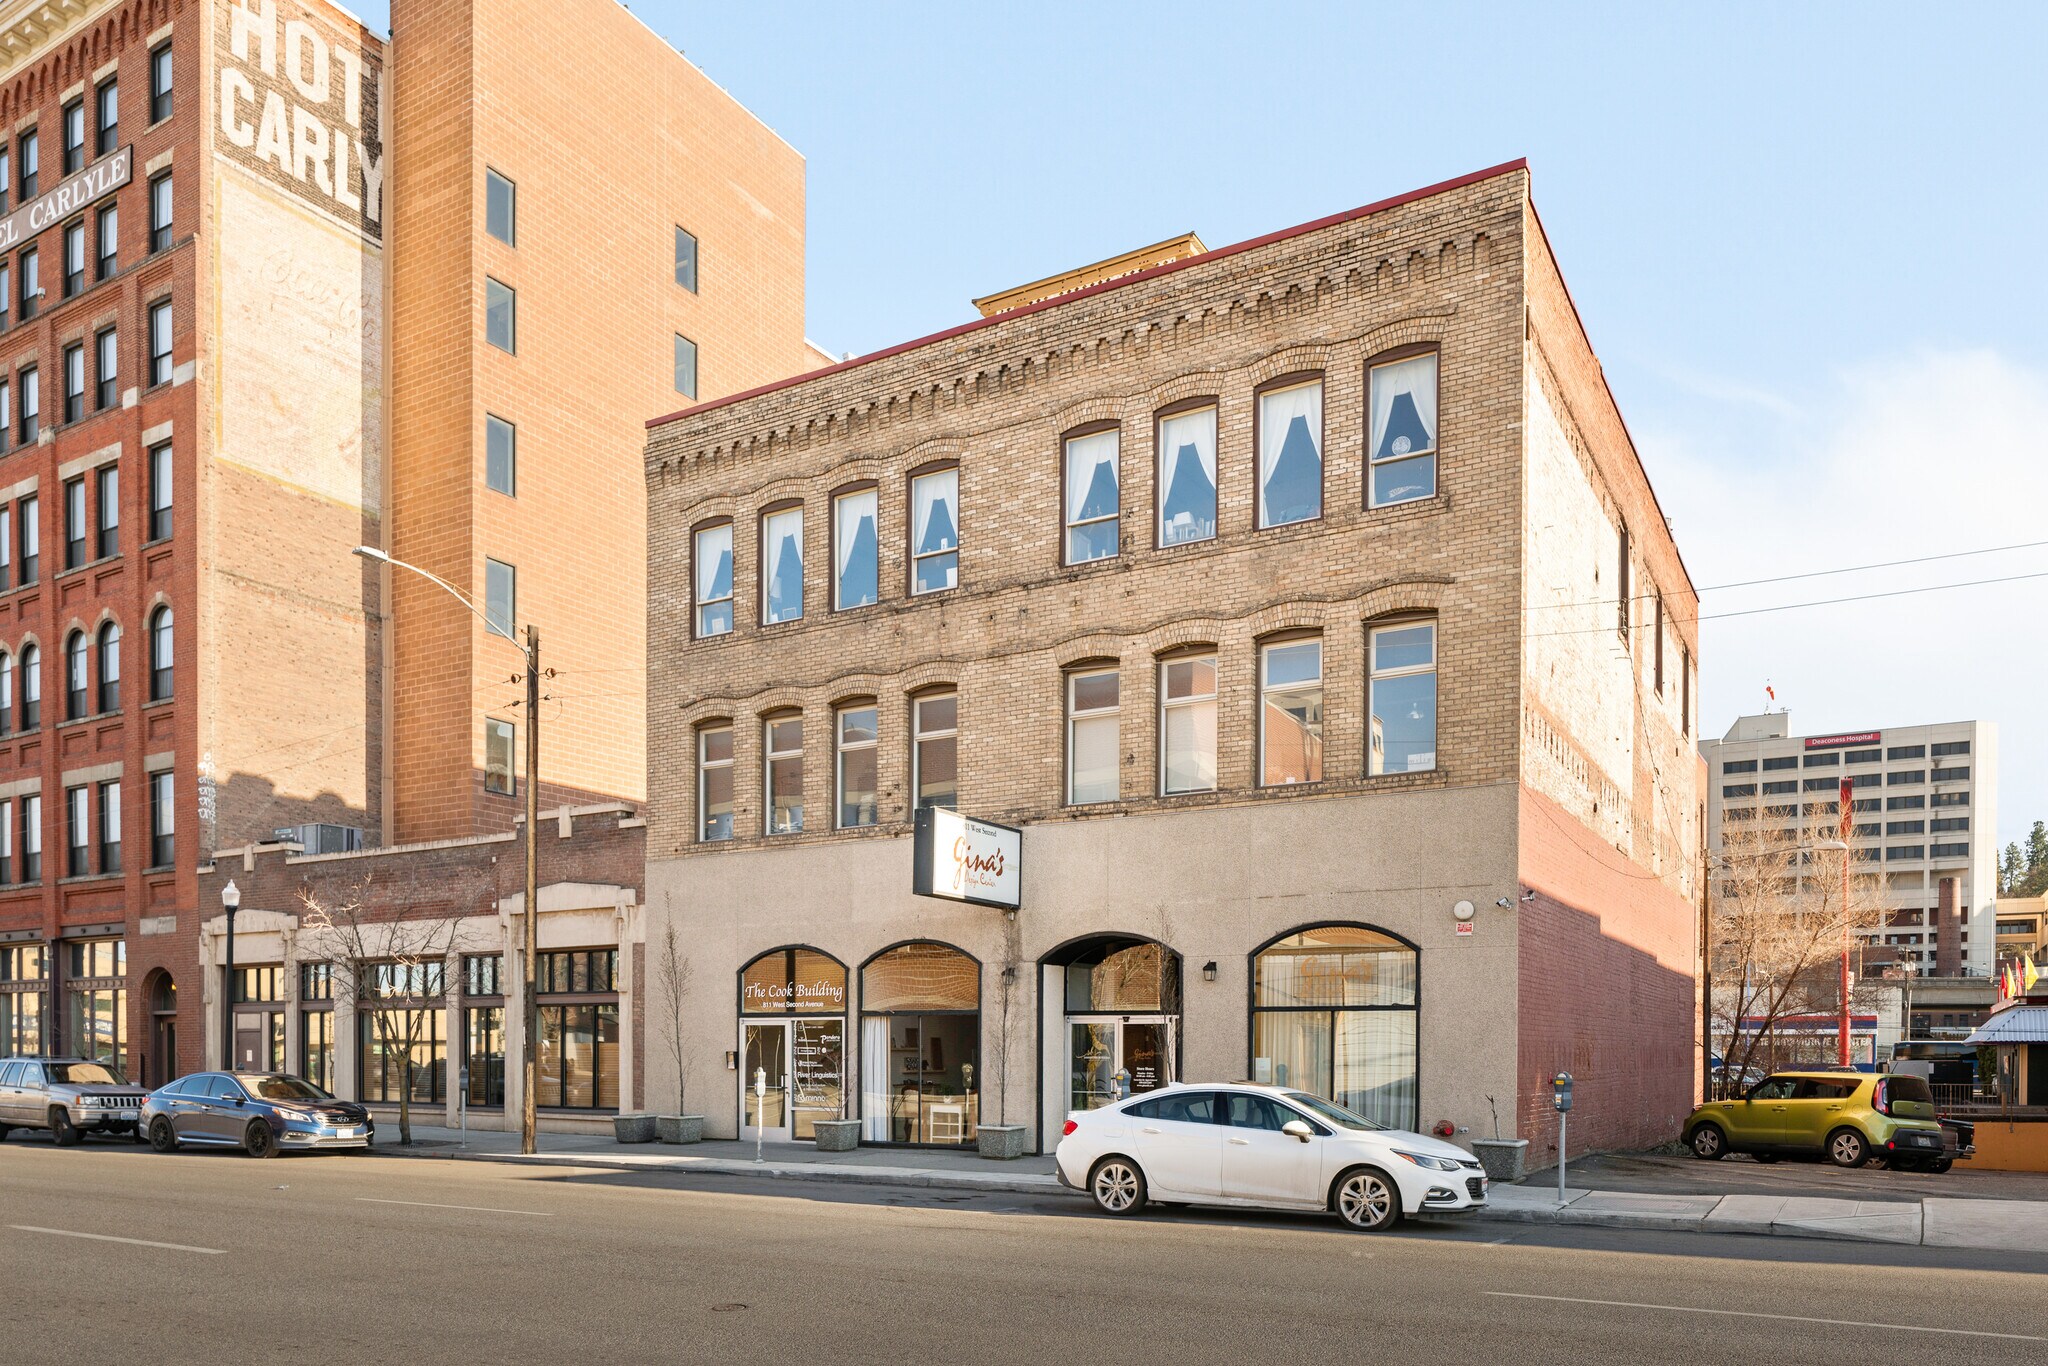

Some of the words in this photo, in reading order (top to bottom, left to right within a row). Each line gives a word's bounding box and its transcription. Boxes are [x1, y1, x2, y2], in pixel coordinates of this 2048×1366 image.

[231, 0, 383, 142] HOT
[29, 154, 125, 230] CARLYLE
[1812, 737, 1846, 745] Deaconess
[1846, 734, 1873, 742] Hospital
[745, 982, 766, 998] The
[768, 981, 793, 997] Cook
[795, 980, 843, 1003] Building
[811, 1071, 838, 1079] Linguistics
